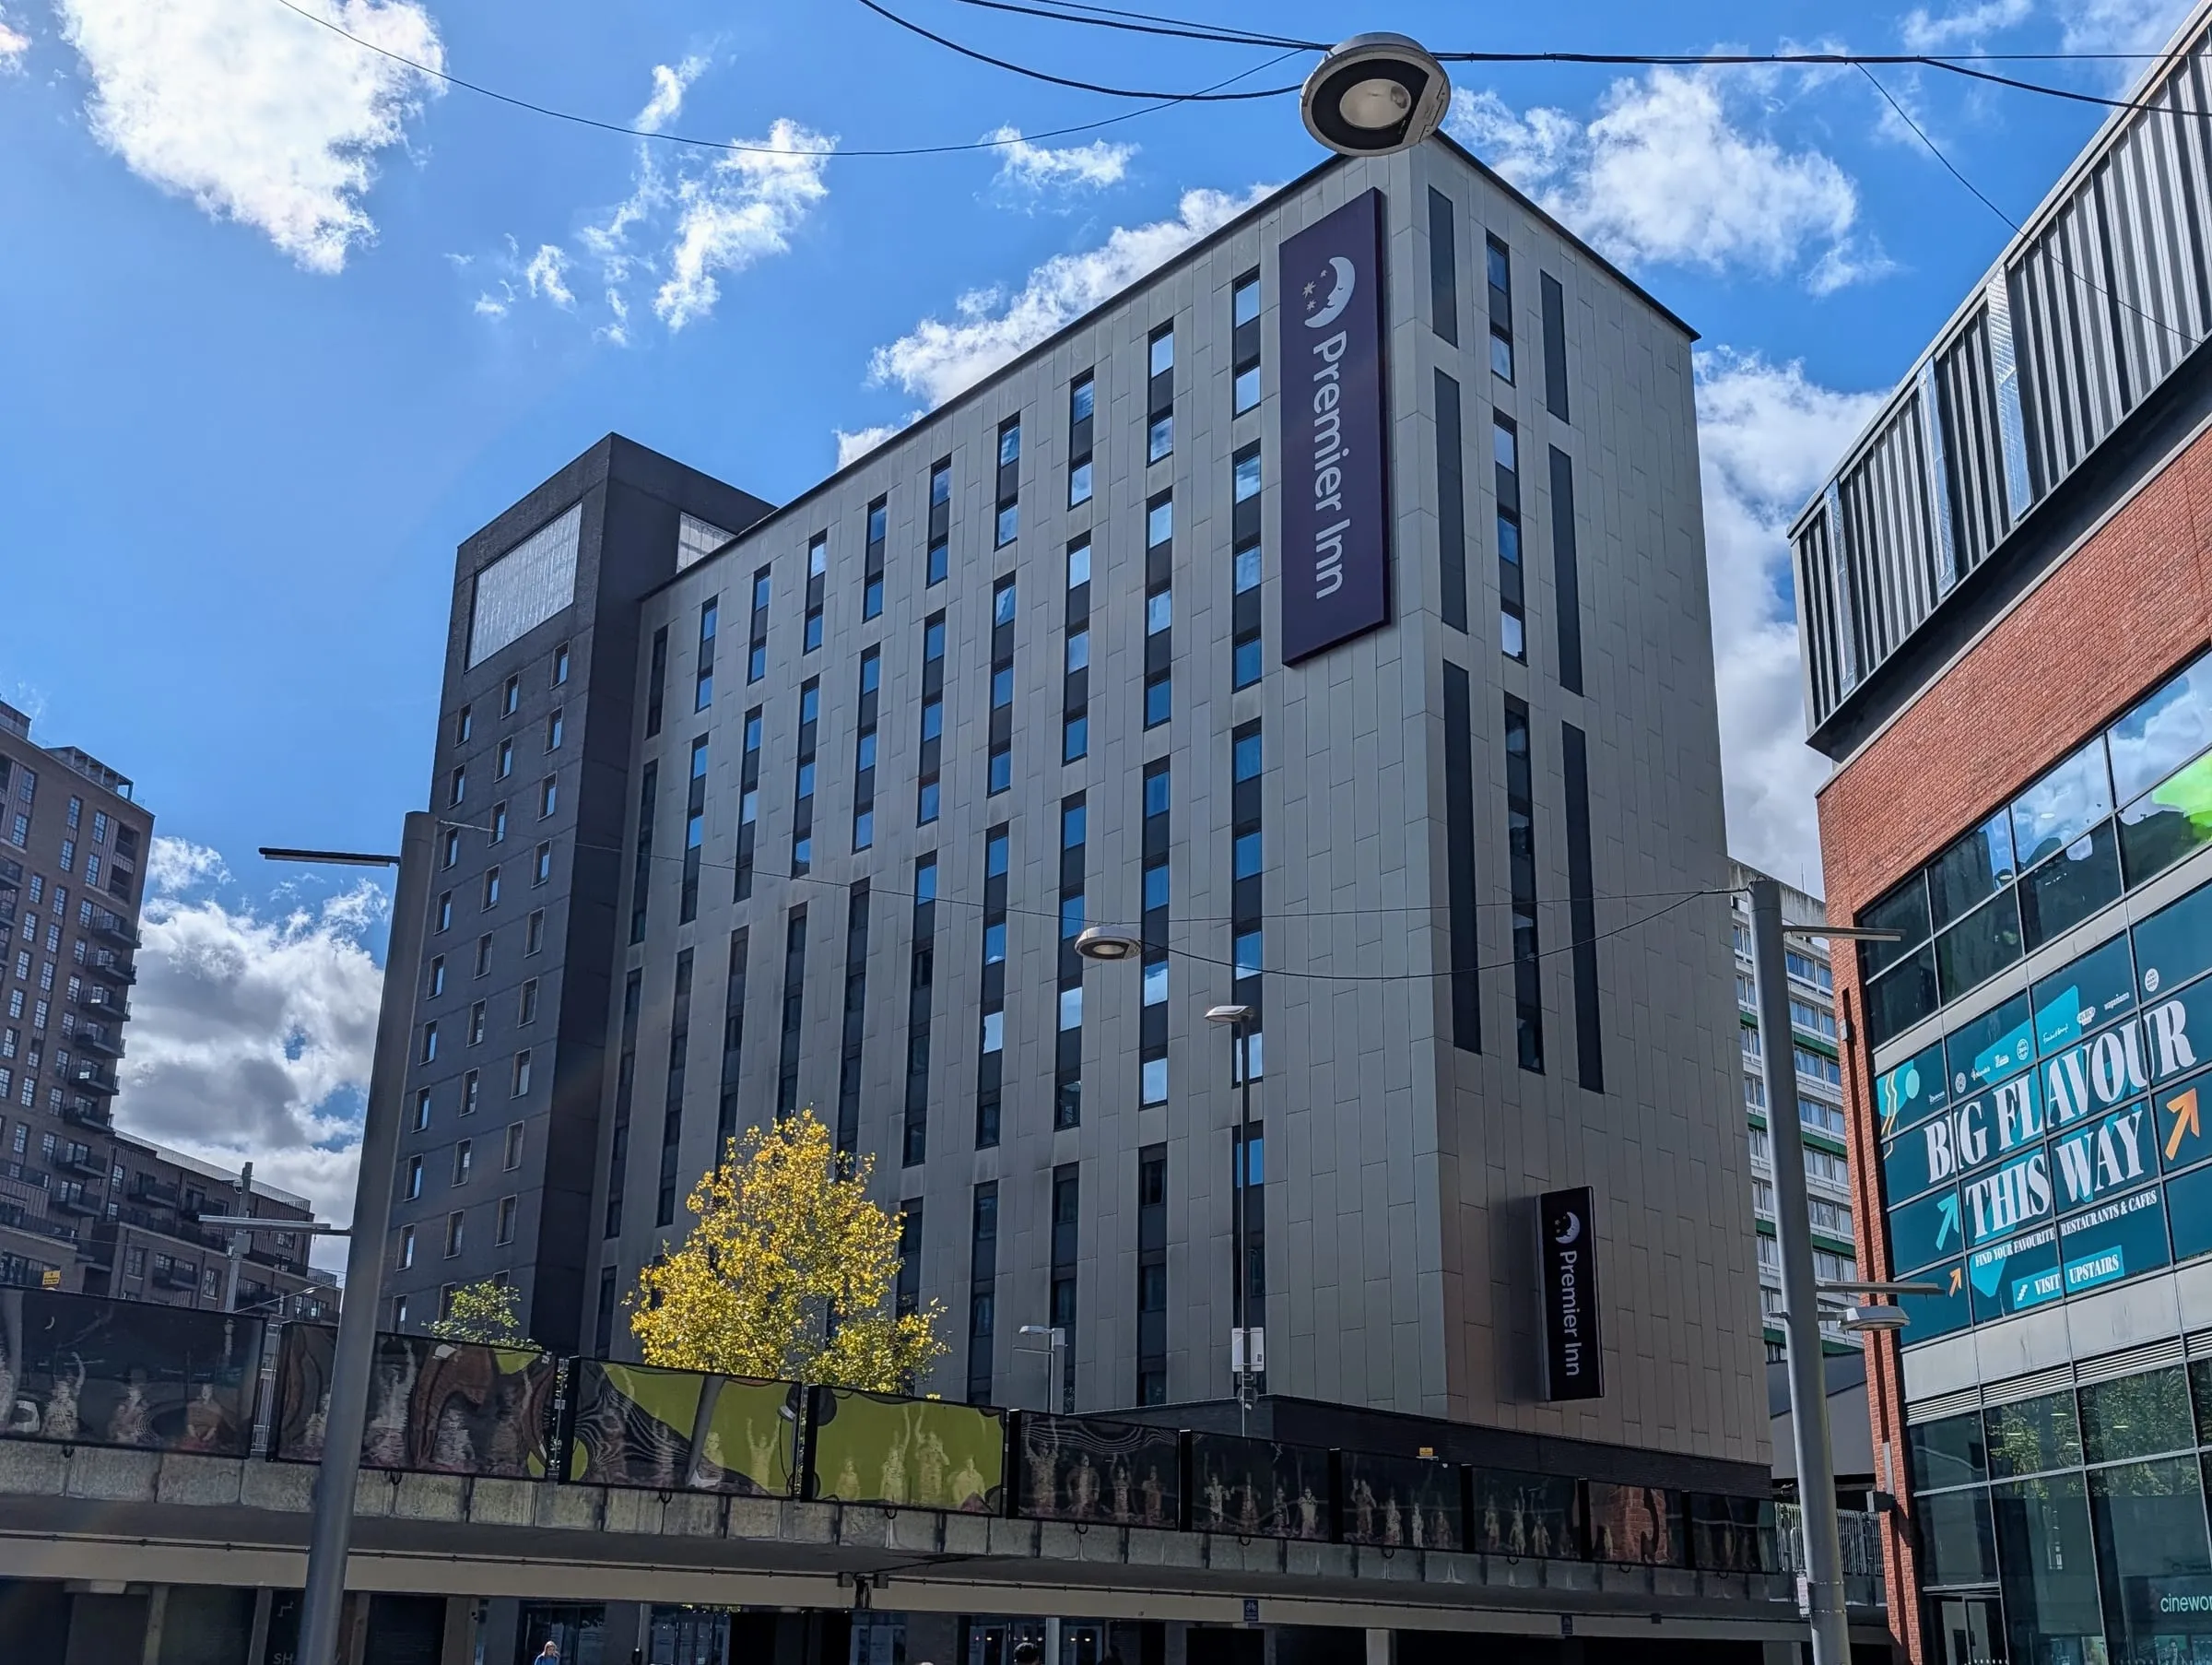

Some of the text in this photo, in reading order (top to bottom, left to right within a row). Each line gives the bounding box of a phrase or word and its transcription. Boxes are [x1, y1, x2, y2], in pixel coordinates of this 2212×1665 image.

[1312, 330, 1351, 600] Premier Inn
[1924, 1000, 2197, 1184] BIG FLAVOUR
[1965, 1110, 2144, 1239] THIS WAY
[1975, 1189, 2158, 1268] FIND YOUR FAVOURITE RESTAURANTS & CAFES
[1559, 1250, 1582, 1376] Premier Inn
[2034, 1253, 2119, 1296] VISIT UPSTAIRS
